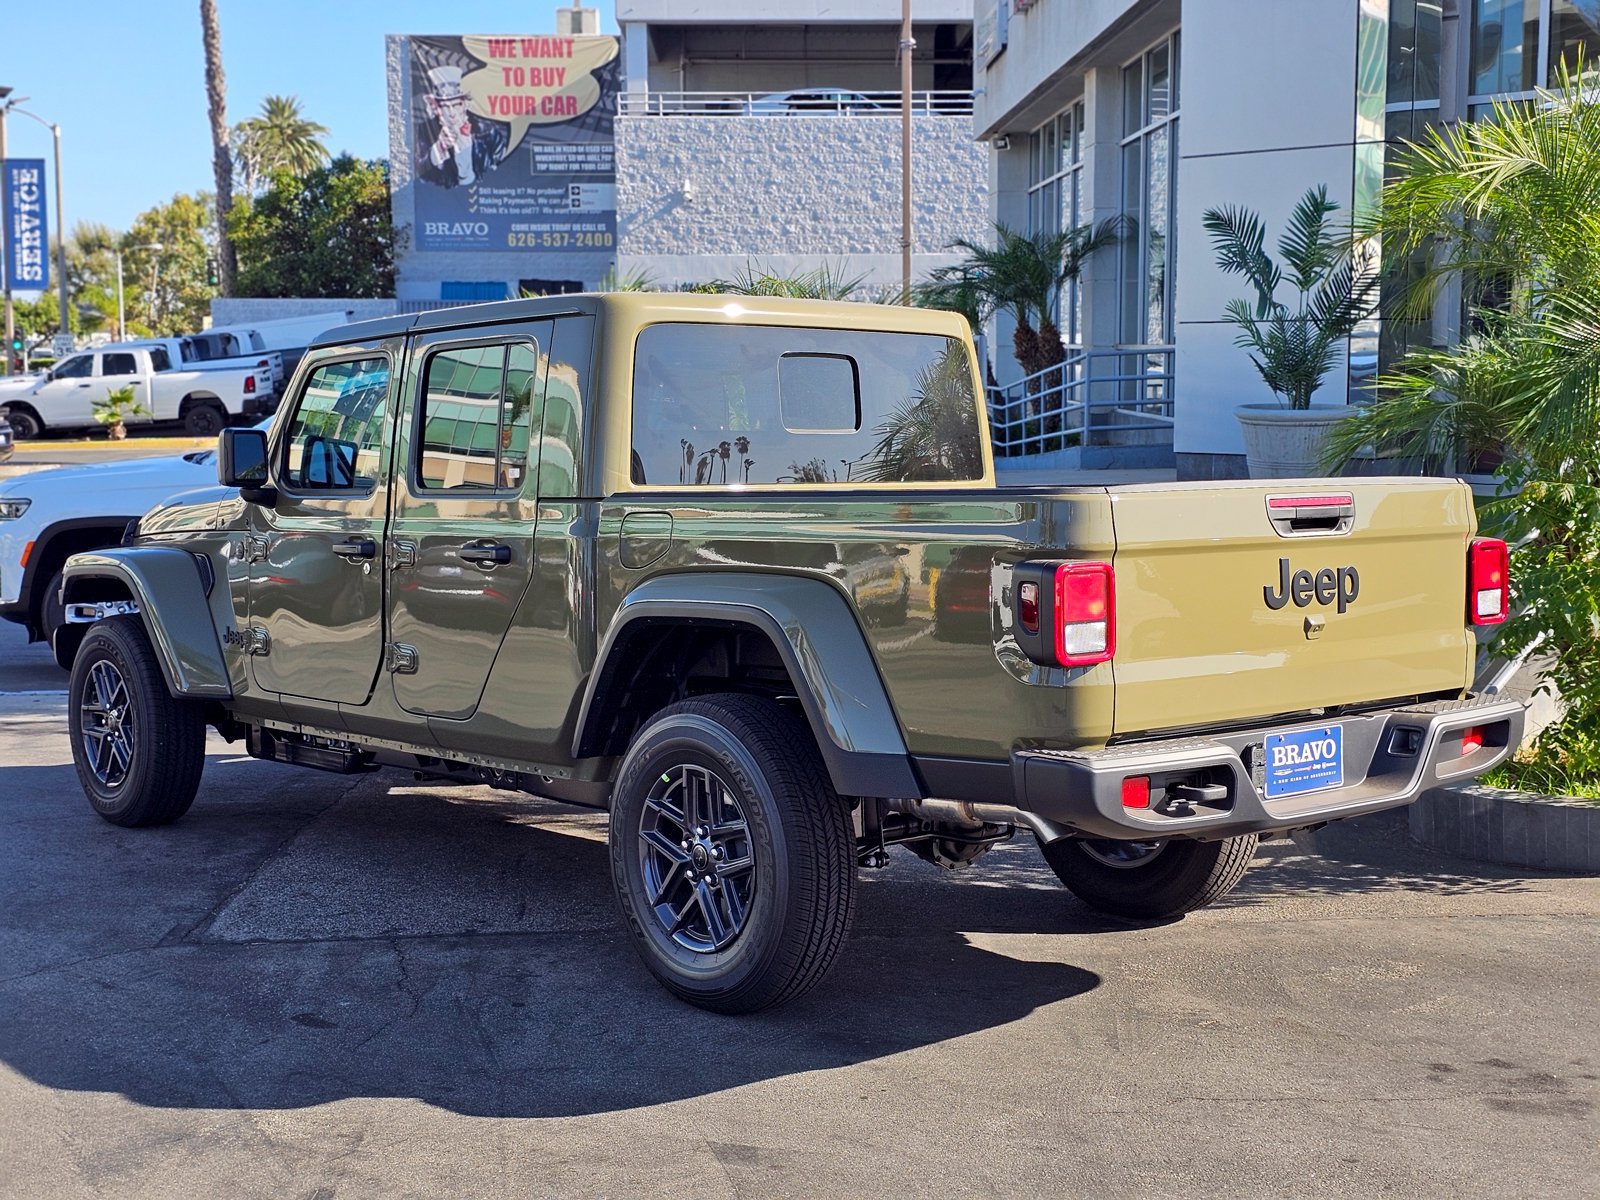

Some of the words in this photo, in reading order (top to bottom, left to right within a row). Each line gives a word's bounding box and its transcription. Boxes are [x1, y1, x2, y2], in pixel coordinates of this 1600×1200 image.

[487, 38, 517, 58] WE
[520, 38, 575, 58] WANT
[501, 66, 526, 87] TO
[529, 66, 567, 87] BUY
[487, 95, 537, 116] YOUR
[541, 95, 578, 116] CAR
[20, 168, 42, 281] SERVICE
[424, 221, 489, 236] BRAVO
[508, 232, 613, 247] 626-537-2400
[1264, 556, 1360, 614] Jeep
[223, 625, 245, 648] Jeep
[1271, 738, 1337, 767] BRAVO
